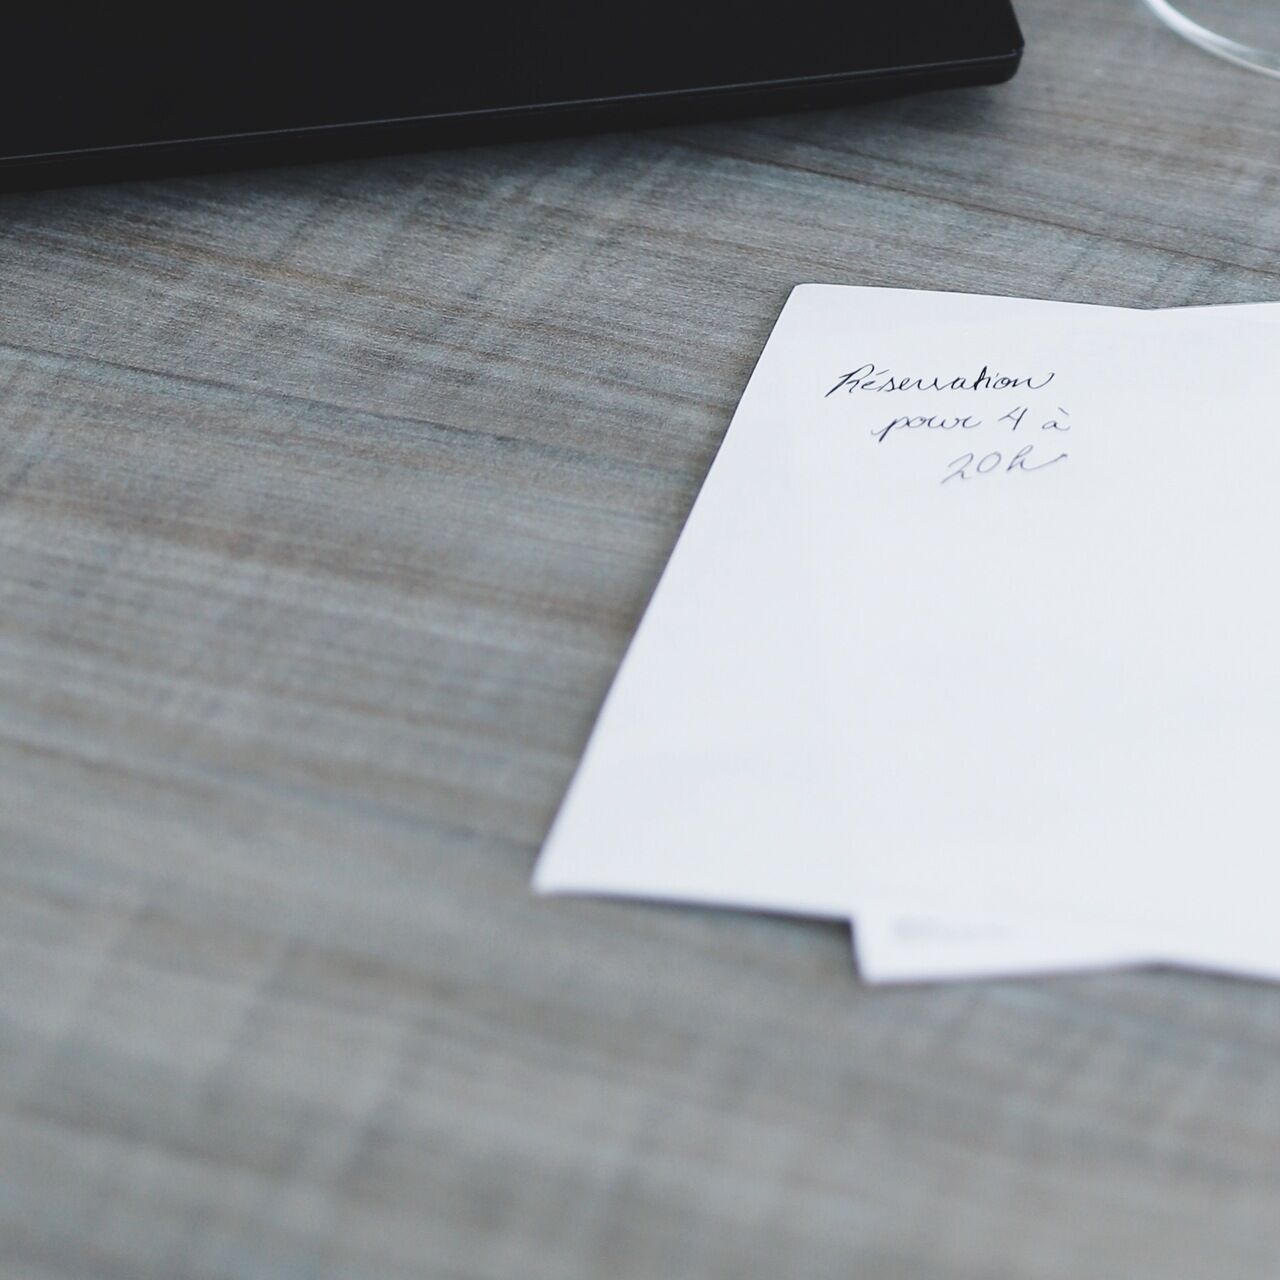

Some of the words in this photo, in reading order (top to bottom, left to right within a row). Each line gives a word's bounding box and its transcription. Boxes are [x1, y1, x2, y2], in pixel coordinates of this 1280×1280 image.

[824, 363, 1055, 398] Réservation
[870, 413, 983, 443] pour
[997, 405, 1028, 431] 4
[1041, 406, 1072, 432] à
[940, 444, 1069, 484] 20h
